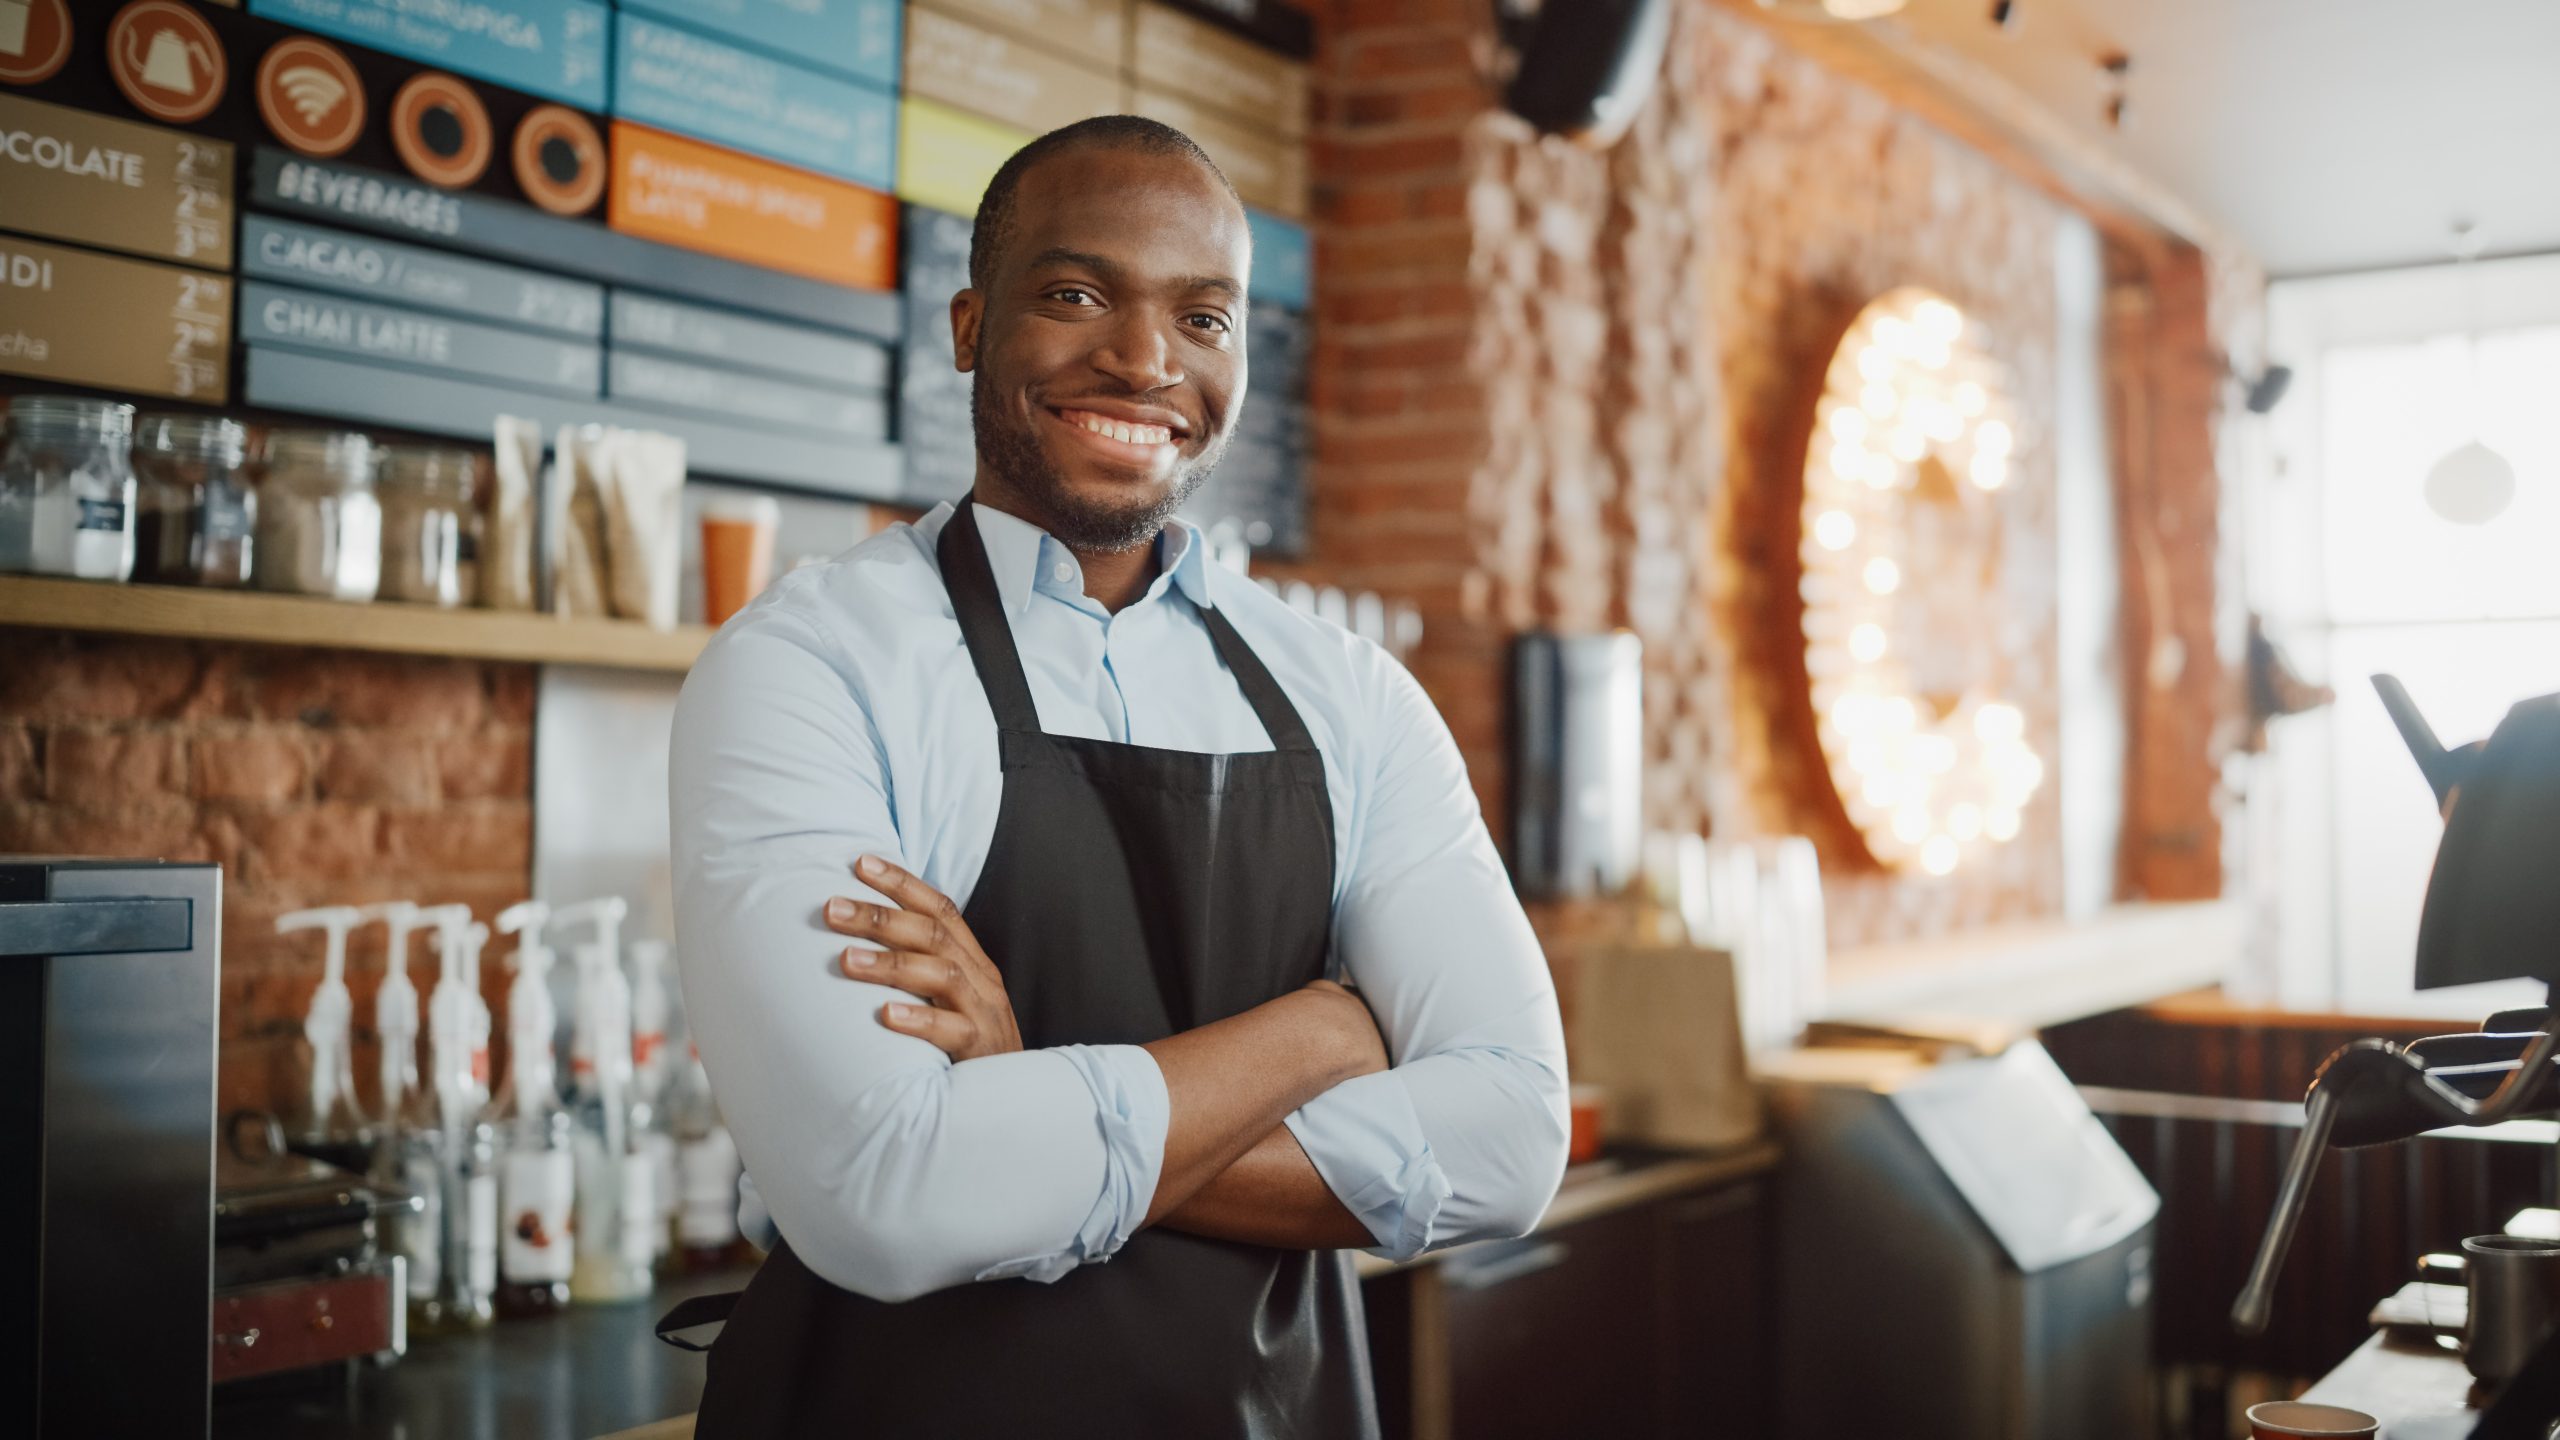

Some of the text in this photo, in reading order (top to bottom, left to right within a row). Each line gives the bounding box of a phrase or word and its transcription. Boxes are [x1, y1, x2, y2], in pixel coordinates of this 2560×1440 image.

[0, 129, 145, 188] COLATE
[277, 162, 461, 236] BEVERAGES
[0, 252, 54, 291] DI
[260, 232, 385, 284] CACAO
[263, 299, 351, 344] CHAI
[357, 313, 449, 362] LATTE
